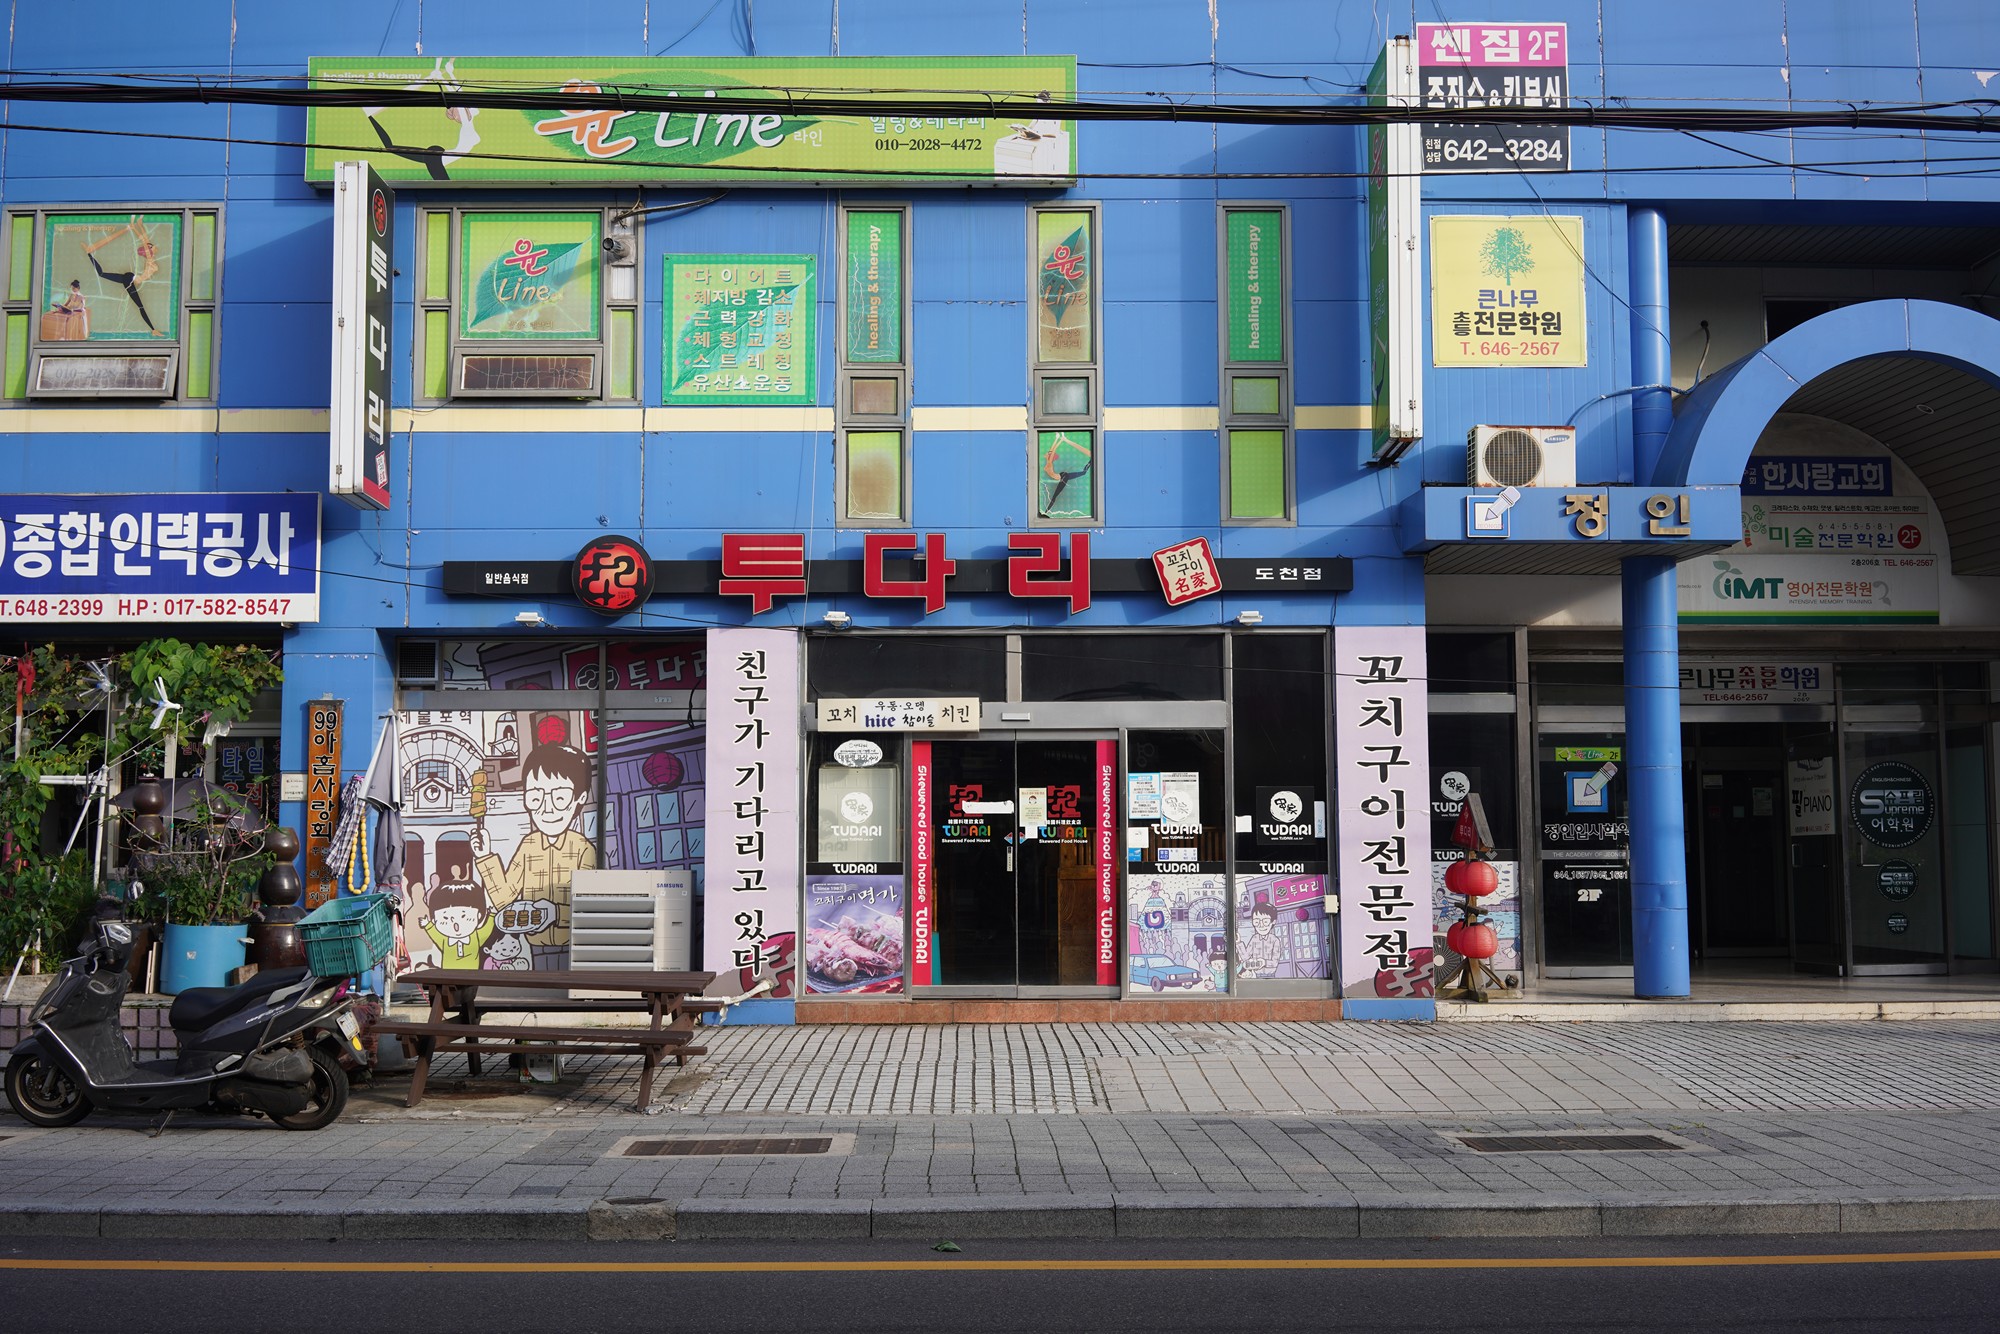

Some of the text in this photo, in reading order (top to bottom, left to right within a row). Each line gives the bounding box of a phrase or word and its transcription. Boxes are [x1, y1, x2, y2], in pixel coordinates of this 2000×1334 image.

[528, 30, 559, 61] 2F
[323, 71, 365, 84] healing
[377, 71, 421, 84] therapy
[793, 129, 823, 147] 라인
[875, 137, 982, 151] 010-2028-4472
[1425, 138, 1441, 150] 친절
[1425, 152, 1441, 163] 상담
[1444, 138, 1562, 162] 642-3284
[693, 269, 793, 286] 다이어트
[498, 277, 551, 301] Line
[867, 225, 881, 350] healing & therapy
[1043, 283, 1088, 306] Line
[1247, 225, 1262, 349] healing & therapy
[694, 289, 793, 306] 체지방 감소
[1477, 289, 1539, 309] 큰나무
[693, 310, 793, 328] 근력강화
[368, 240, 387, 445] 투다리
[693, 331, 792, 349] 체형교정
[1480, 341, 1560, 356] 646-2567
[692, 353, 792, 370] 스트레칭
[1762, 462, 1884, 491] 한사랑교회
[1565, 494, 1691, 537] 정인
[1769, 526, 1919, 548] 미술 전문학원 2F
[1167, 549, 1192, 566] 꼬치
[1883, 559, 1897, 567] TEL
[1900, 559, 1934, 567] 646-2567
[719, 533, 1091, 615] 투다리
[1177, 560, 1203, 576] 구이
[1255, 567, 1322, 580] 도천점
[485, 573, 529, 585] 일반음식점
[1175, 572, 1208, 593] 名家
[1787, 580, 1873, 597] 영어전문학원
[164, 598, 291, 616] 017-582-8547
[1780, 667, 1820, 690] 학원
[827, 706, 856, 723] 꼬치
[865, 714, 935, 728] hite 참이슬
[941, 705, 970, 723] 치킨
[1610, 751, 1619, 760] 2F
[1804, 795, 1832, 813] PIANO
[1885, 790, 1923, 804] 슈프림
[732, 650, 769, 976] 친구가 기다리고 있다
[1355, 656, 1414, 970] 꼬치구이전문점
[831, 825, 882, 837] TUDARI
[942, 825, 991, 837] TUDARI
[1039, 826, 1088, 838] TUDARI
[1151, 823, 1202, 835] TUDARI
[1260, 824, 1311, 836] TUDARI
[833, 863, 877, 873] TUDARI
[1155, 863, 1199, 873] TUDARI
[1259, 863, 1304, 873] TUDARI
[917, 863, 927, 903] house
[1103, 863, 1112, 903] house
[1290, 881, 1319, 897] 투다리
[1577, 889, 1603, 902] 2F
[916, 906, 928, 964] TUDARI
[1101, 906, 1112, 964] TUDARI
